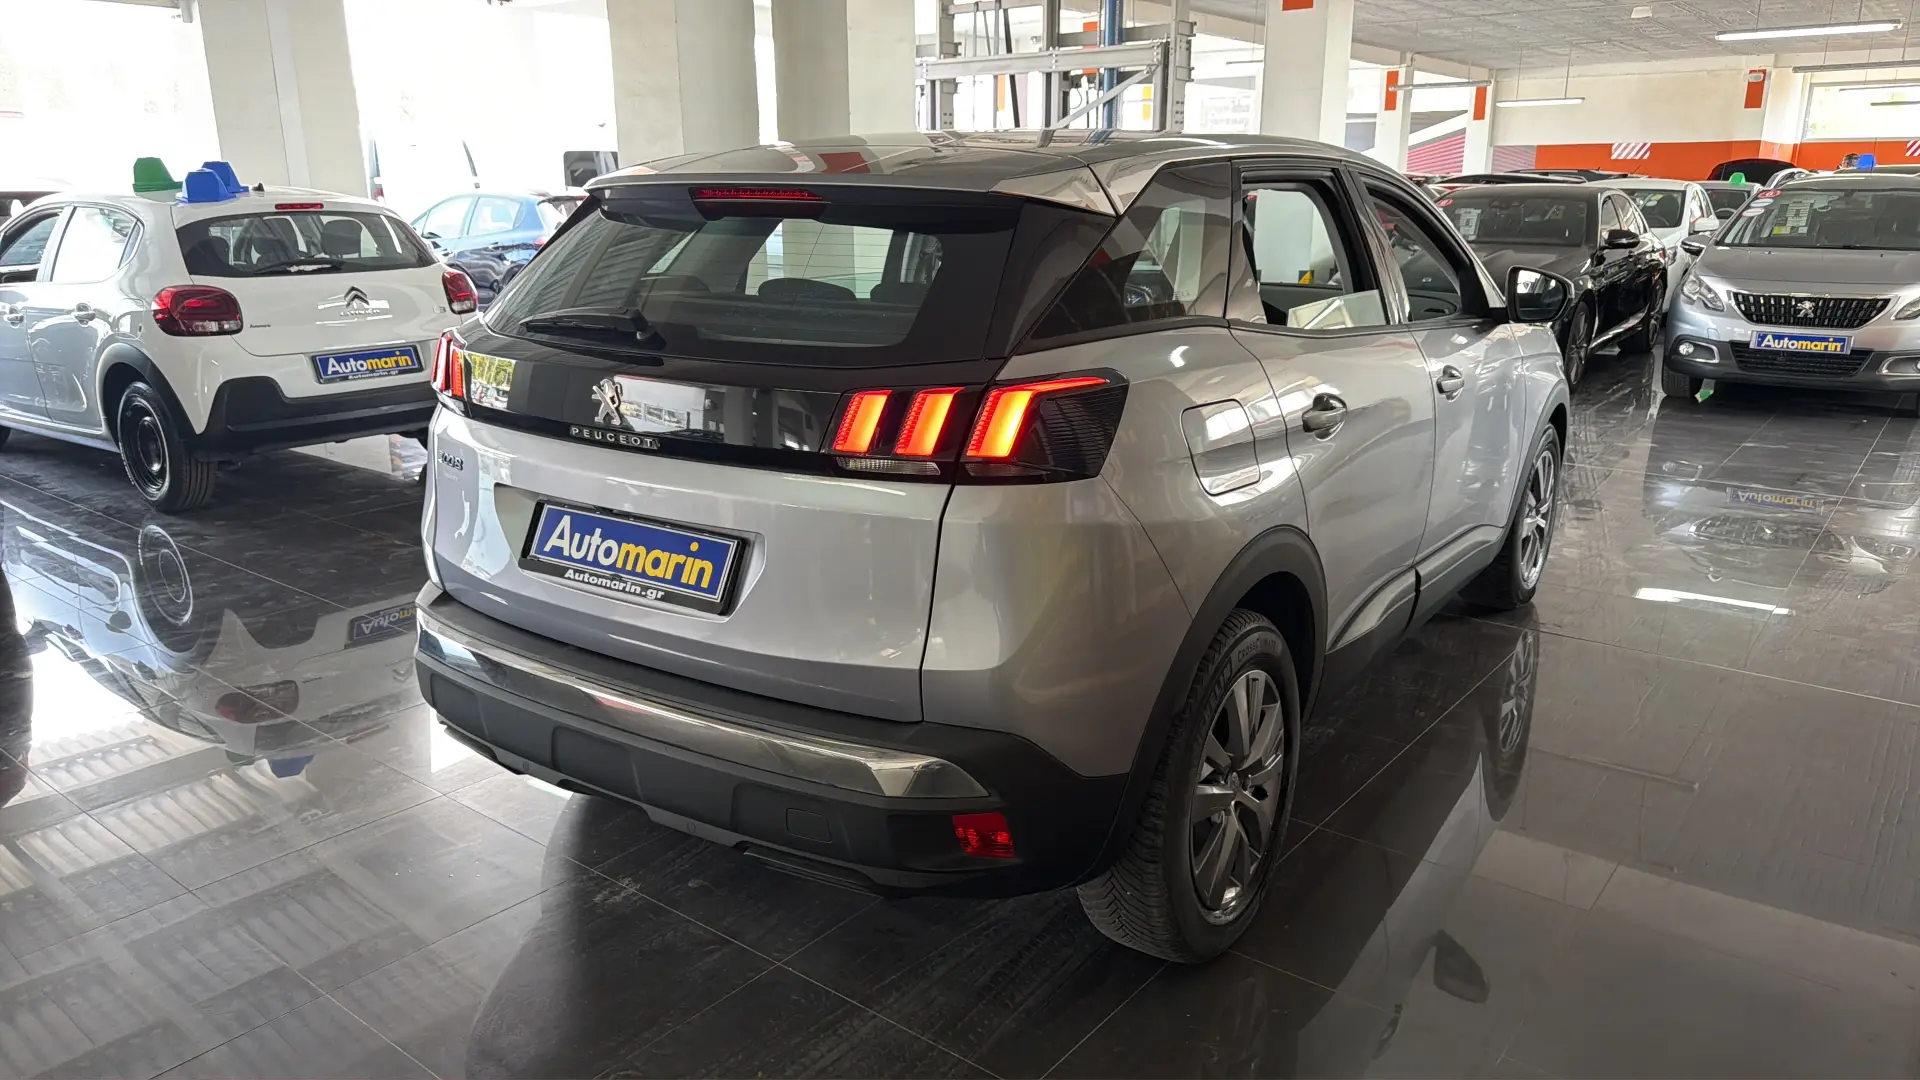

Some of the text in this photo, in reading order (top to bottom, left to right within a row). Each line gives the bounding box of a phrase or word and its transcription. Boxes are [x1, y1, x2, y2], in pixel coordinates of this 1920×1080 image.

[1761, 334, 1842, 352] Automarin
[326, 351, 412, 375] Automarin
[571, 427, 653, 447] PEUGEOT
[543, 515, 714, 588] Automarin
[563, 568, 665, 600] Automarin.gr
